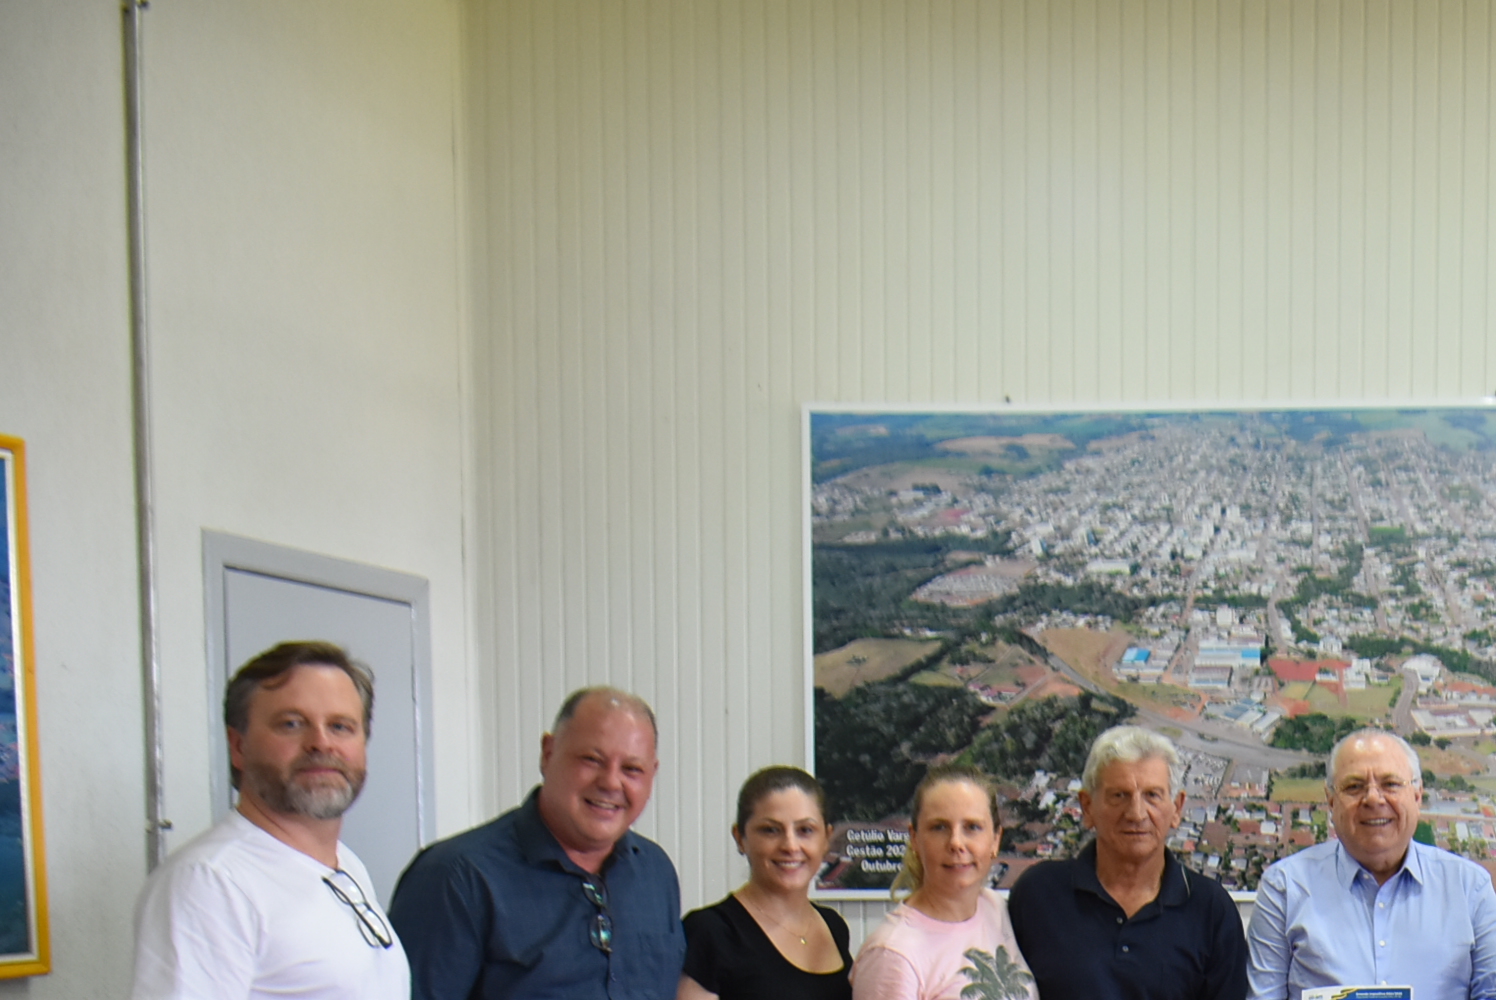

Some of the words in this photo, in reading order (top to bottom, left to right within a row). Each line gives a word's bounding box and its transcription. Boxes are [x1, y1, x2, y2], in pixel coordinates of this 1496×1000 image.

[846, 829, 885, 843] Getúlio
[846, 844, 884, 858] Gestão
[886, 844, 907, 858] 202
